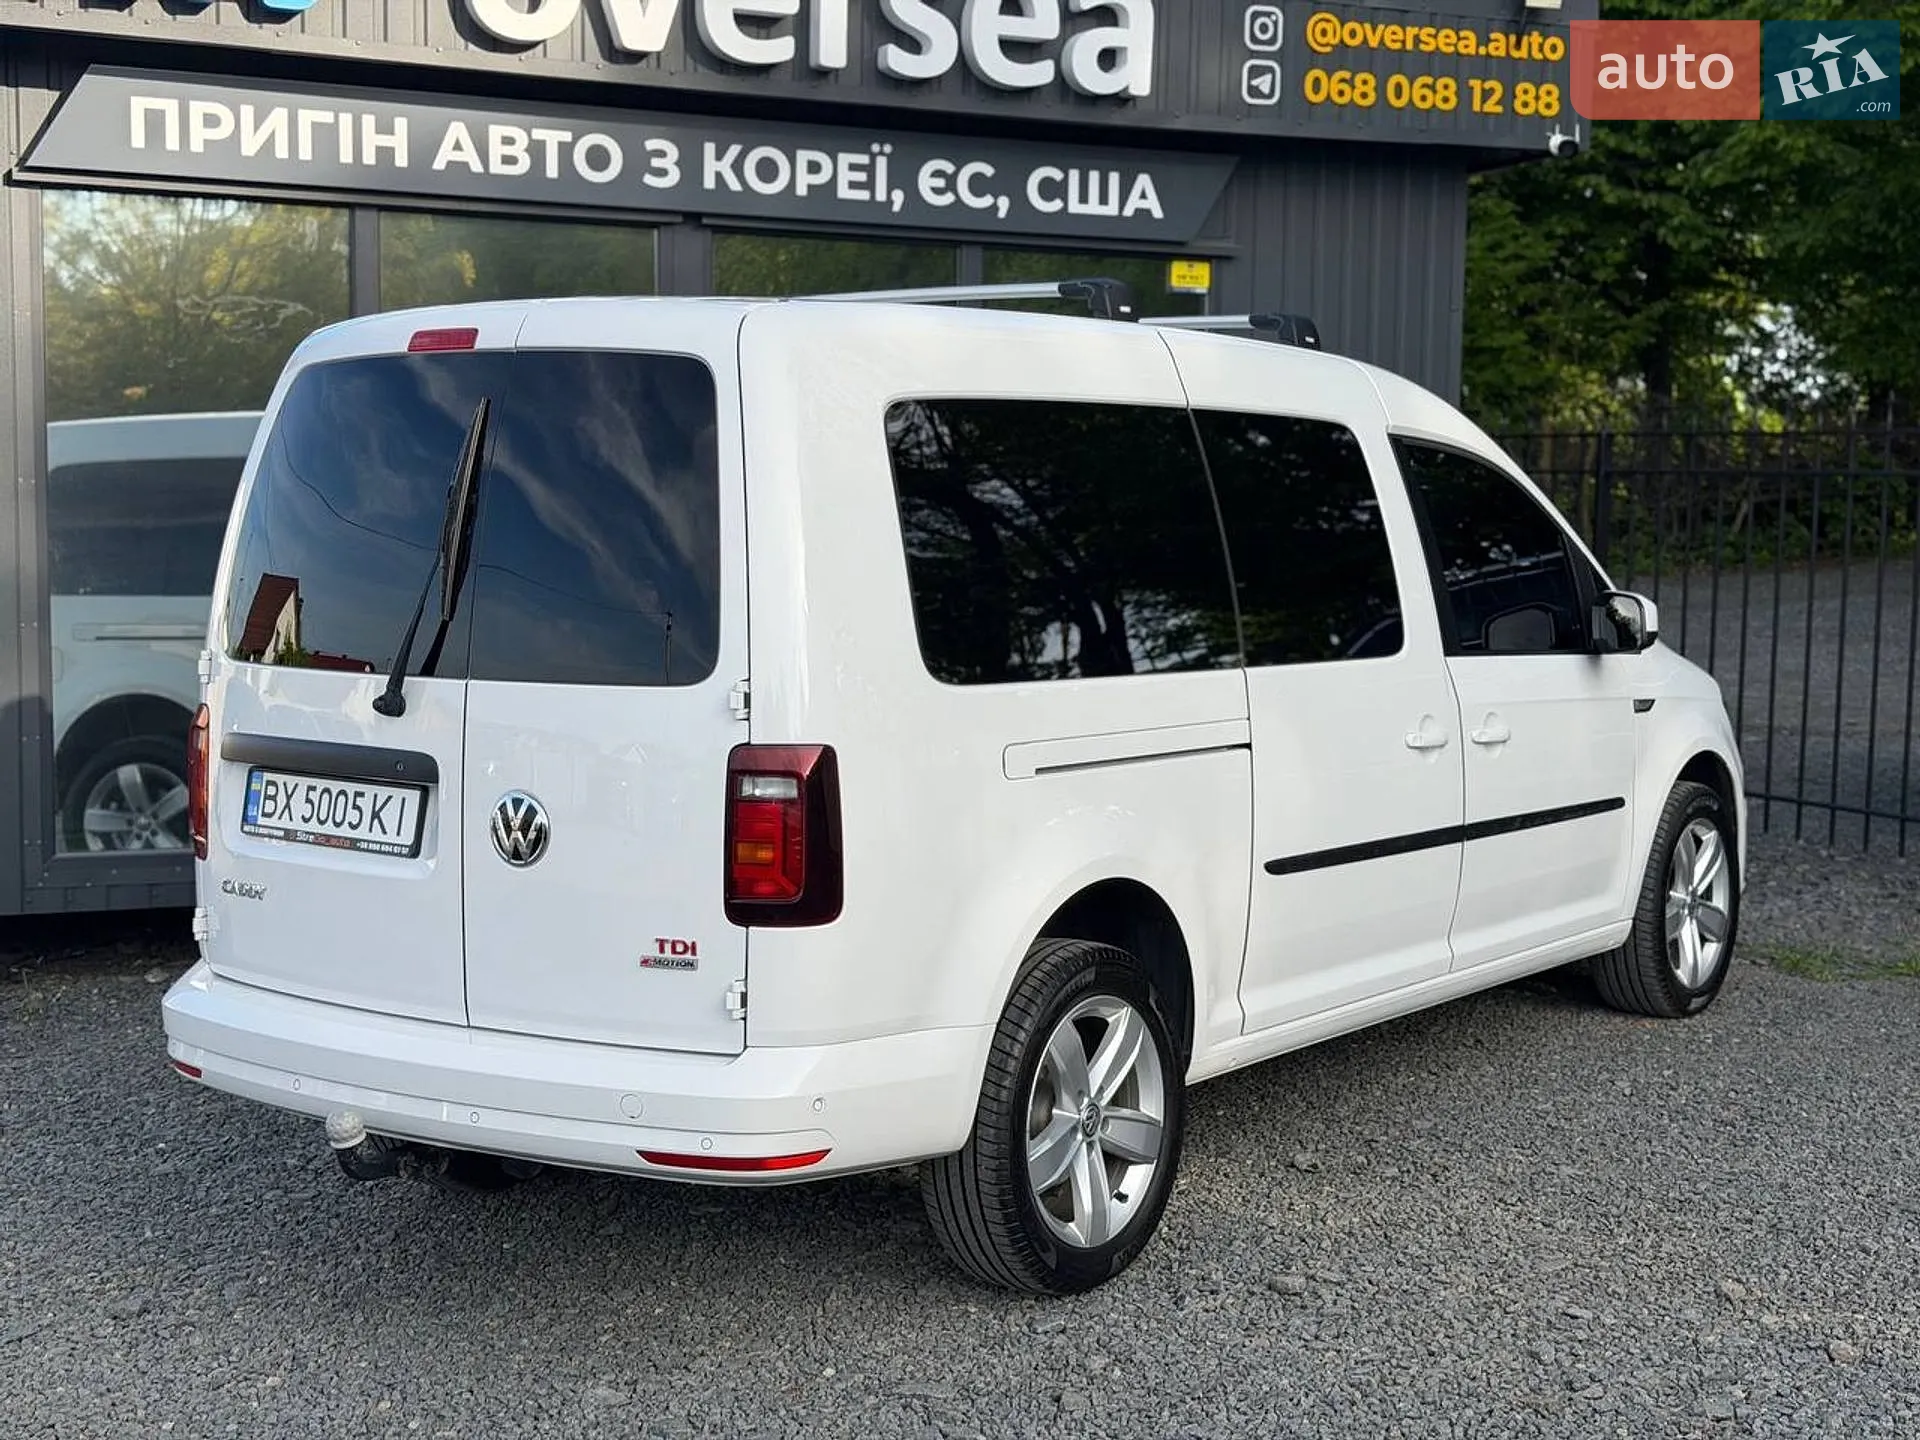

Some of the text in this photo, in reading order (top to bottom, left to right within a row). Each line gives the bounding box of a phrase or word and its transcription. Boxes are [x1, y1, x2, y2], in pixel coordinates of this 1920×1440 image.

[1305, 11, 1566, 61] @oversea.auto
[1304, 68, 1561, 117] 068 068 12 88
[130, 96, 1164, 219] ПРИГІН АВТО З КОРЕЇ, ЄС, США
[261, 779, 406, 837] BX 5005 KI
[655, 937, 697, 956] TDI
